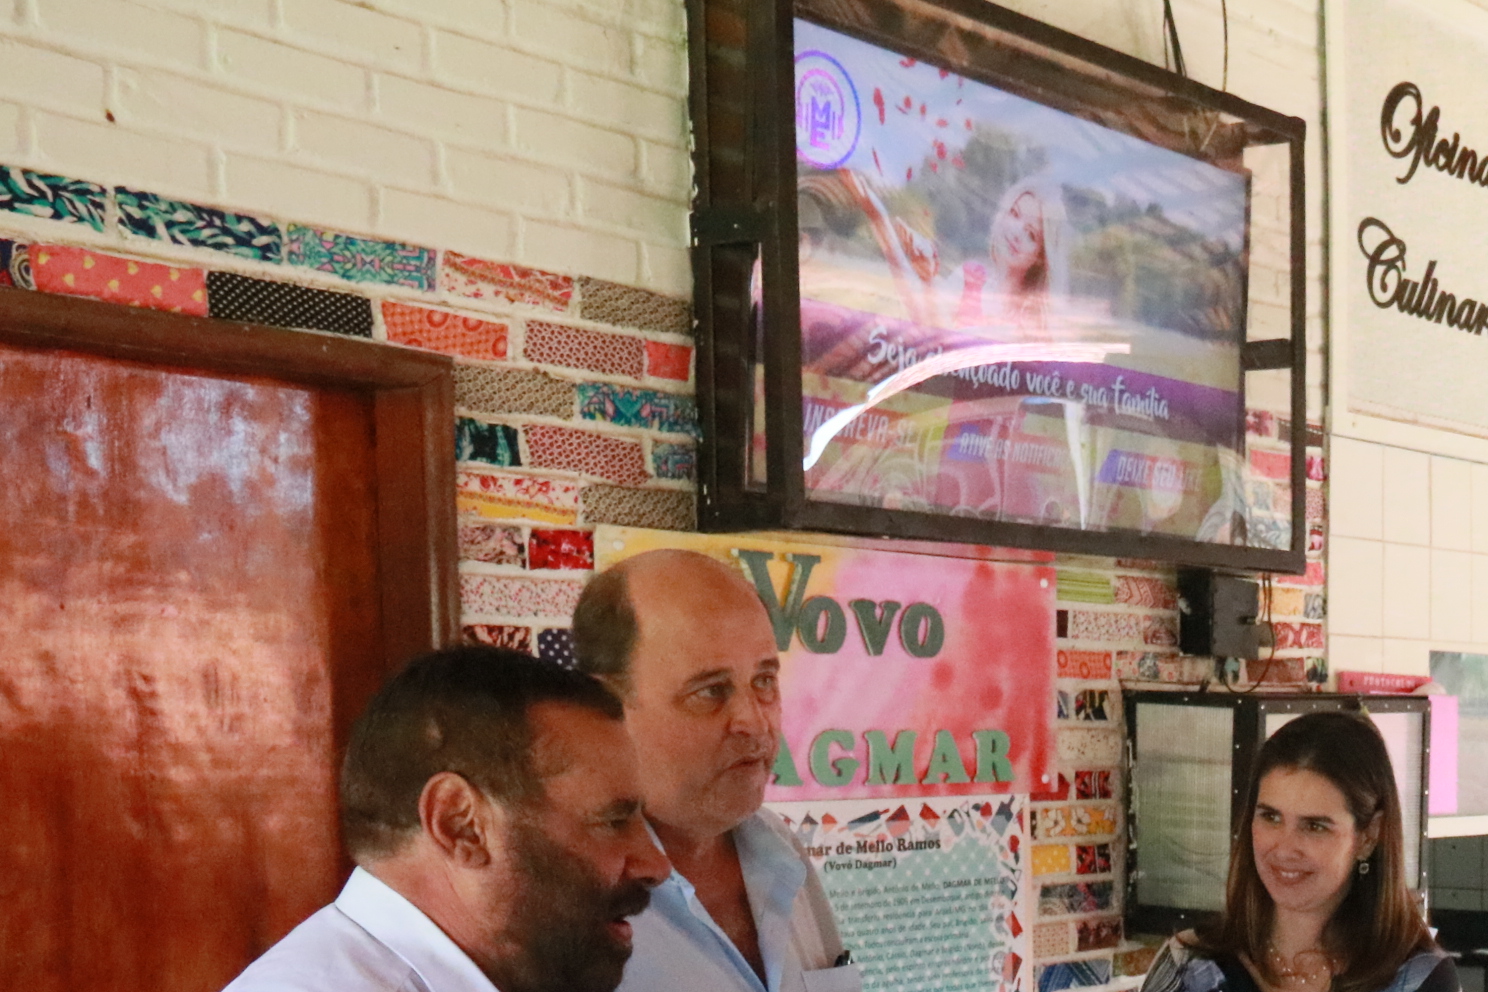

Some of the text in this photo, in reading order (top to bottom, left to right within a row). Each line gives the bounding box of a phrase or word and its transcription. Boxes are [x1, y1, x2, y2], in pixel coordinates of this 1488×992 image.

[1026, 371, 1061, 396] você
[1066, 380, 1076, 398] e
[1081, 383, 1108, 408] sua
[1117, 456, 1150, 484] DEIXE
[773, 728, 1016, 787] AGMAR
[836, 841, 852, 854] de
[856, 839, 894, 854] Mello
[897, 837, 941, 852] Ramos
[855, 857, 897, 871] Dagmar)
[943, 879, 971, 889] DAGMAR
